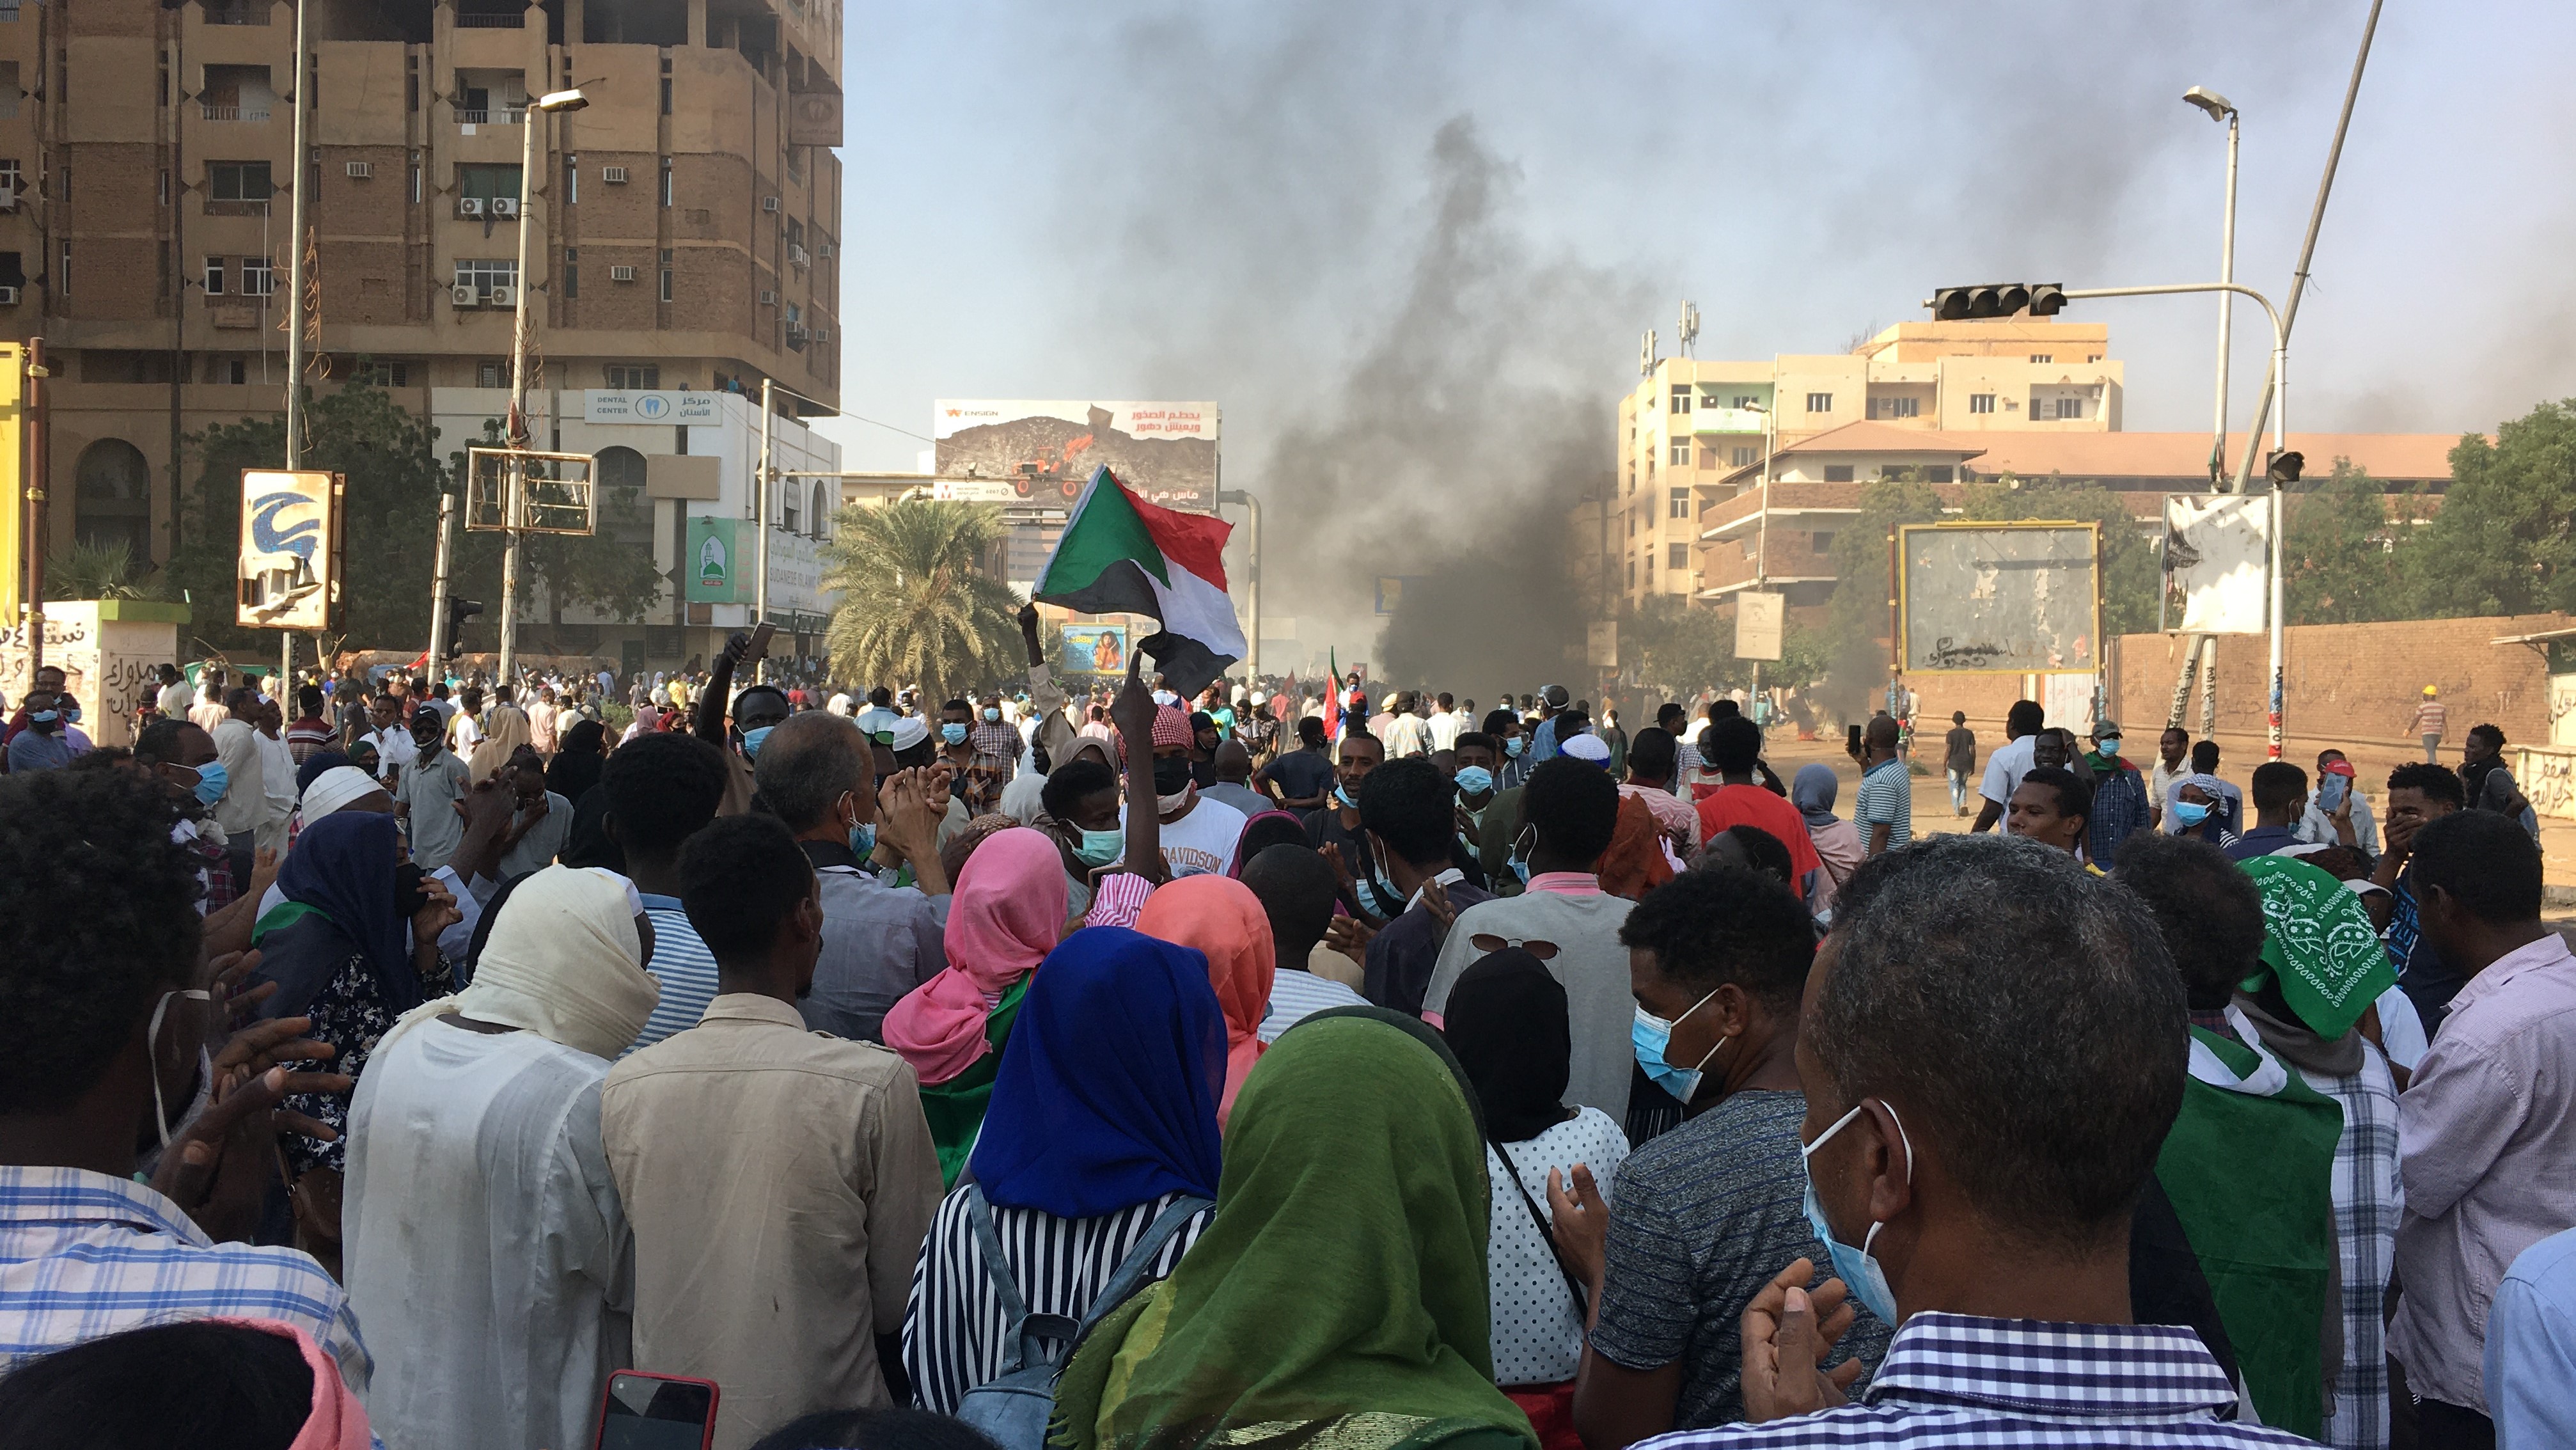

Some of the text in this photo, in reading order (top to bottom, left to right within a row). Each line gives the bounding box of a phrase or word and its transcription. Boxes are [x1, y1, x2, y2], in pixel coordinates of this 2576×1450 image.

[682, 397, 711, 406] مركز
[680, 408, 711, 418] الأسنان
[1131, 410, 1200, 421] يحطم الصخور
[1136, 423, 1161, 432] دهور
[1151, 491, 1169, 503] هي
[1172, 491, 1199, 501] ماس
[769, 567, 797, 587] SUDANESE
[1159, 846, 1223, 874] DAVIDSON
